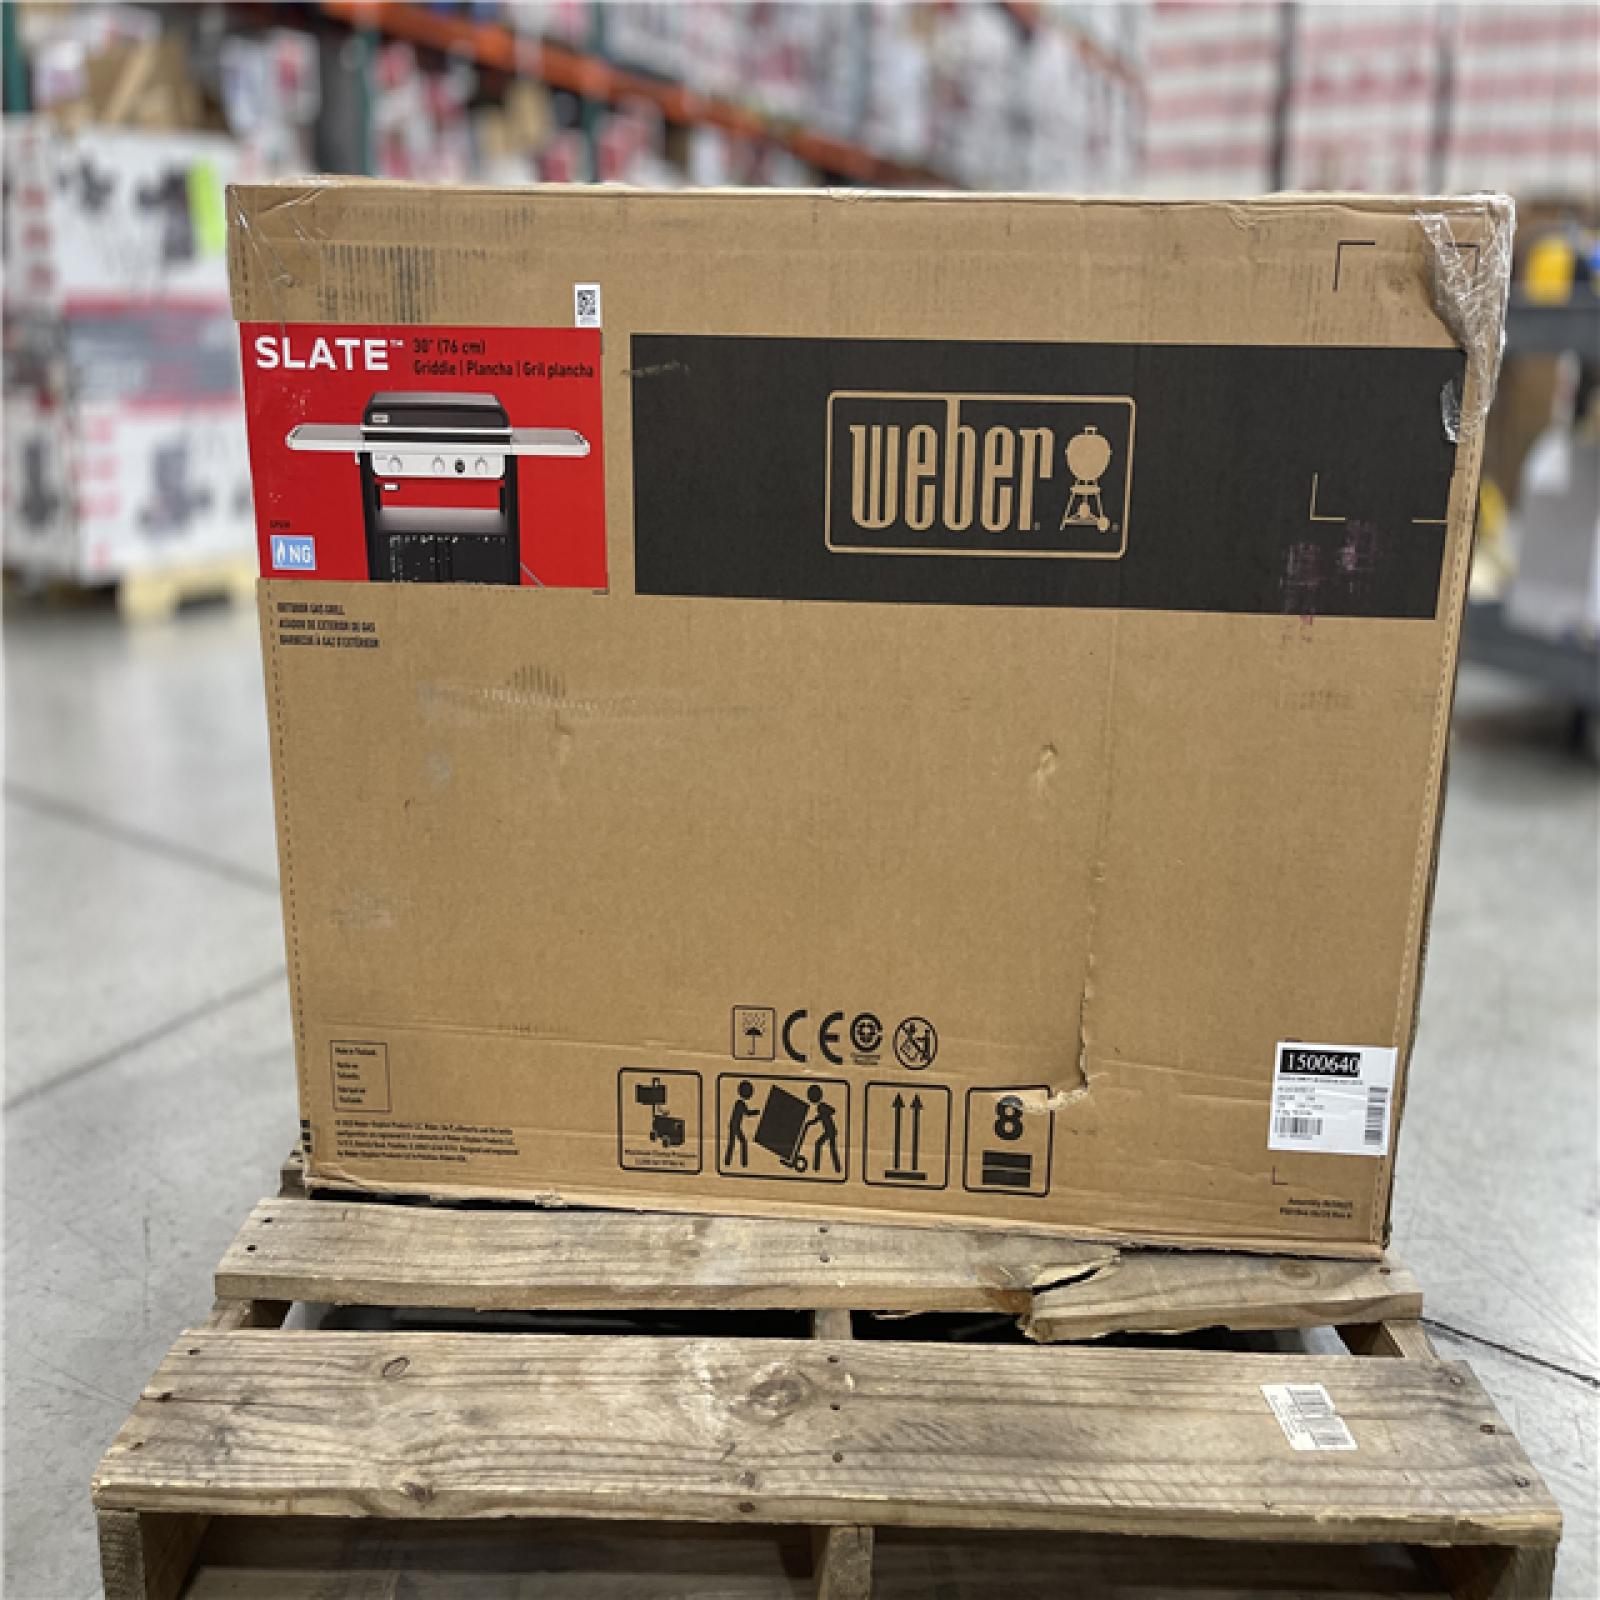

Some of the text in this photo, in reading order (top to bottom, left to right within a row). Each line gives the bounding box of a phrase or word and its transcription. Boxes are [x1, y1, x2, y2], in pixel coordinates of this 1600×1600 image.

[437, 339, 458, 355] (76
[462, 340, 486, 355] cm)
[414, 360, 593, 379] Griddle Plancha Gril plancha
[849, 398, 1055, 533] weber
[289, 544, 311, 564] NG
[1288, 1052, 1361, 1074] 1500640
[994, 1095, 1024, 1141] 8
